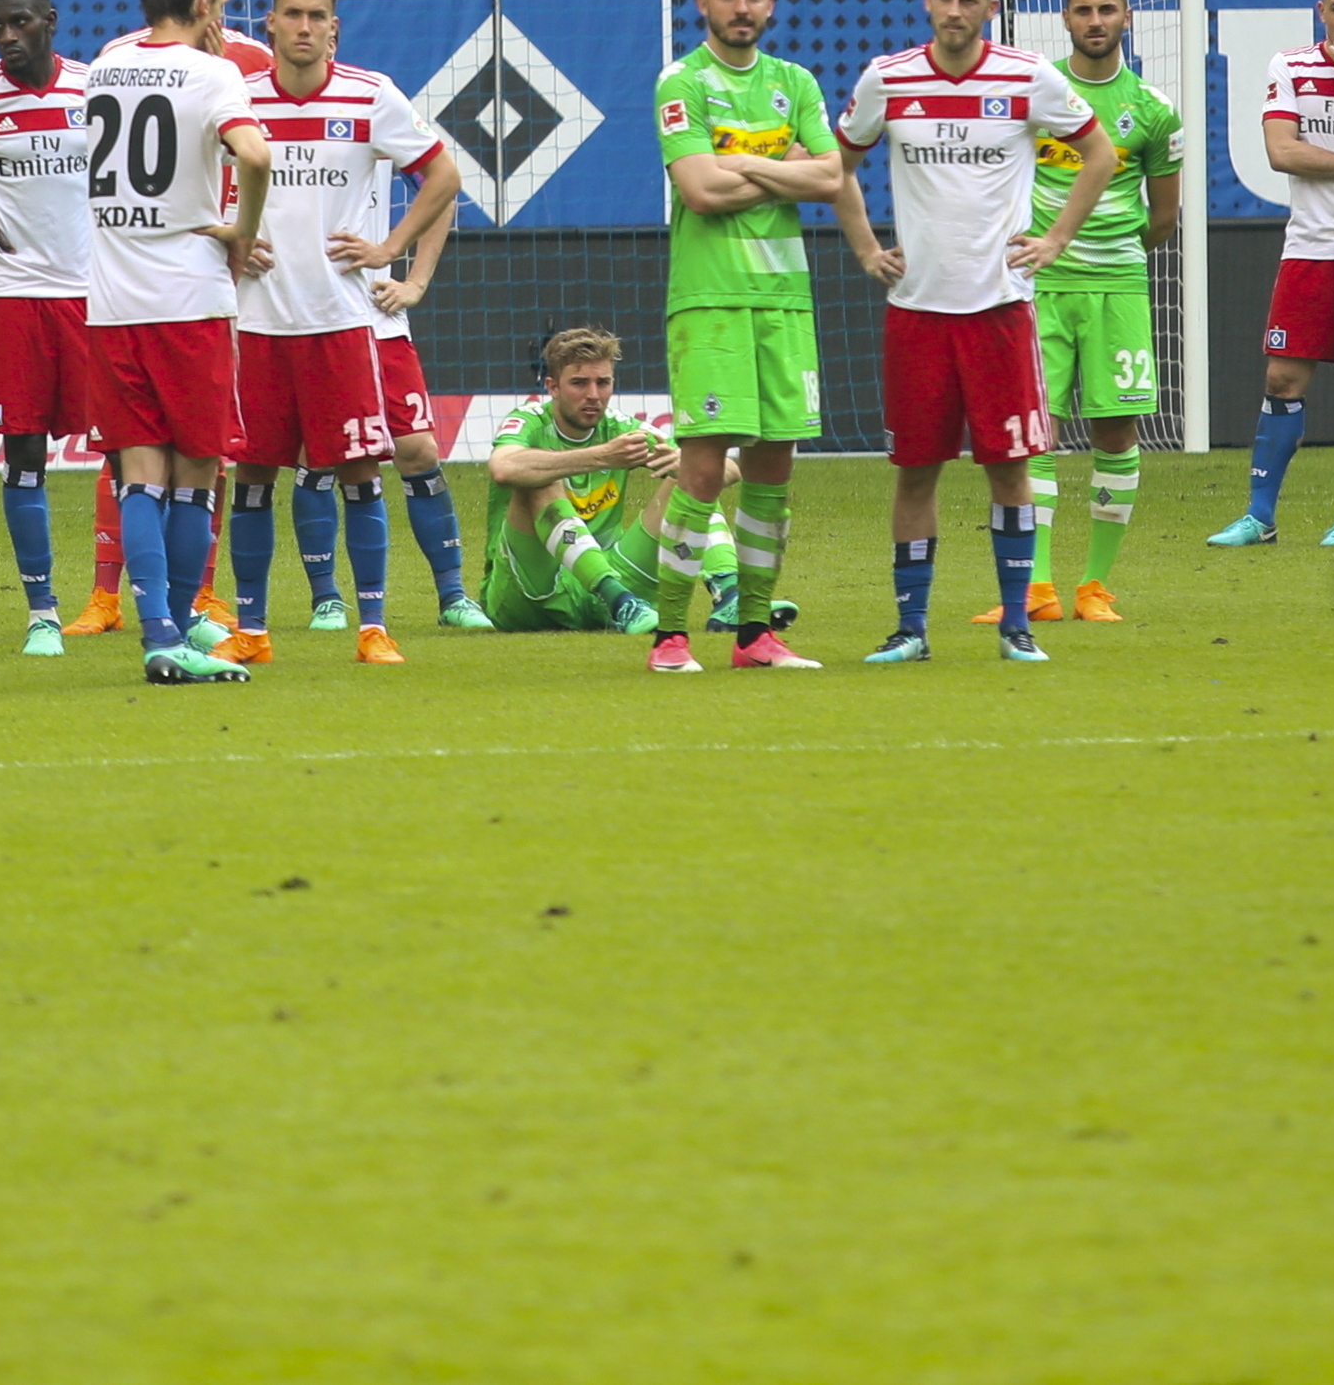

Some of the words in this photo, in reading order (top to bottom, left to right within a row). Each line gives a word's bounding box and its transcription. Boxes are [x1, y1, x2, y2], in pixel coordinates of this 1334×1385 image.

[167, 68, 188, 89] SV
[86, 94, 177, 197] 20
[936, 122, 968, 145] Fly
[30, 136, 61, 160] Fly
[283, 145, 314, 168] Fly
[901, 143, 1006, 166] Emirates
[271, 165, 348, 188] mirates
[1113, 349, 1154, 390] 32
[803, 371, 820, 414] 18
[343, 415, 385, 460] 15
[1003, 411, 1048, 458] 14
